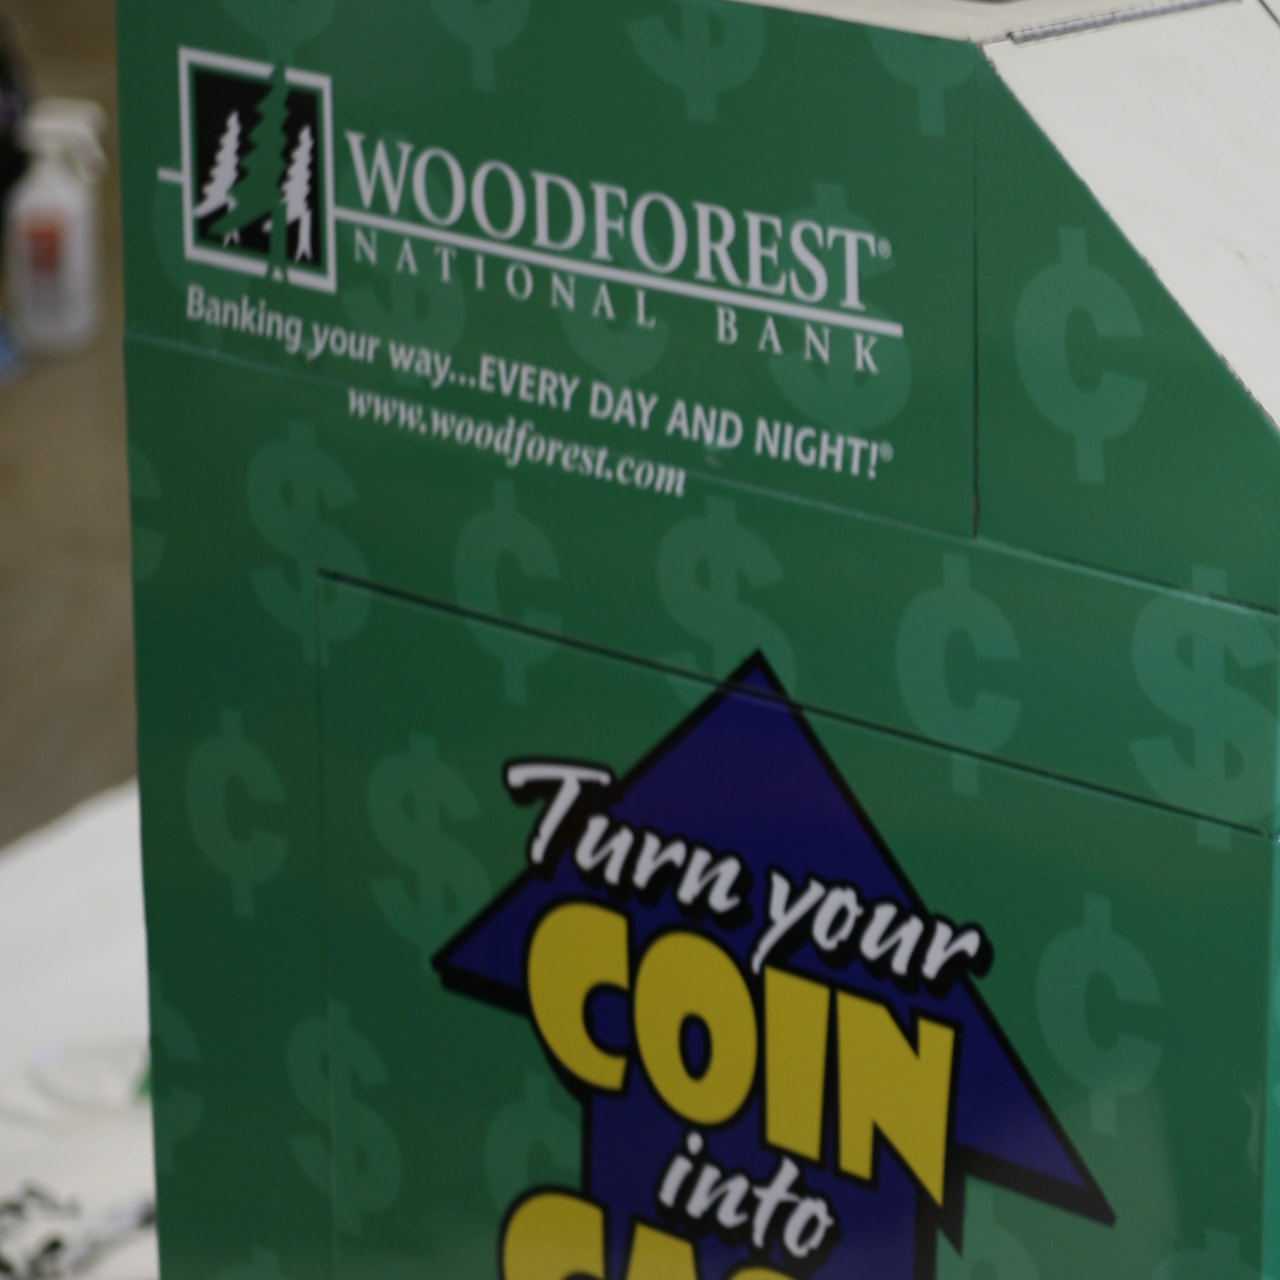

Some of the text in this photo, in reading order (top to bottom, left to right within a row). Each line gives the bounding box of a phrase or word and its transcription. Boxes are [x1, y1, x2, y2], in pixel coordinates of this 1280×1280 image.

[345, 130, 877, 311] WOODFOREST
[354, 230, 879, 375] NATIONAL BANK
[185, 285, 302, 352] Banking
[306, 322, 380, 364] your
[589, 381, 657, 431] DAY
[666, 401, 743, 450] AND
[754, 418, 879, 479] NIGHT!
[347, 387, 686, 496] www.woodforest.com
[507, 761, 980, 979] Turn your
[528, 902, 955, 1209] COIN
[659, 1132, 833, 1263] into
